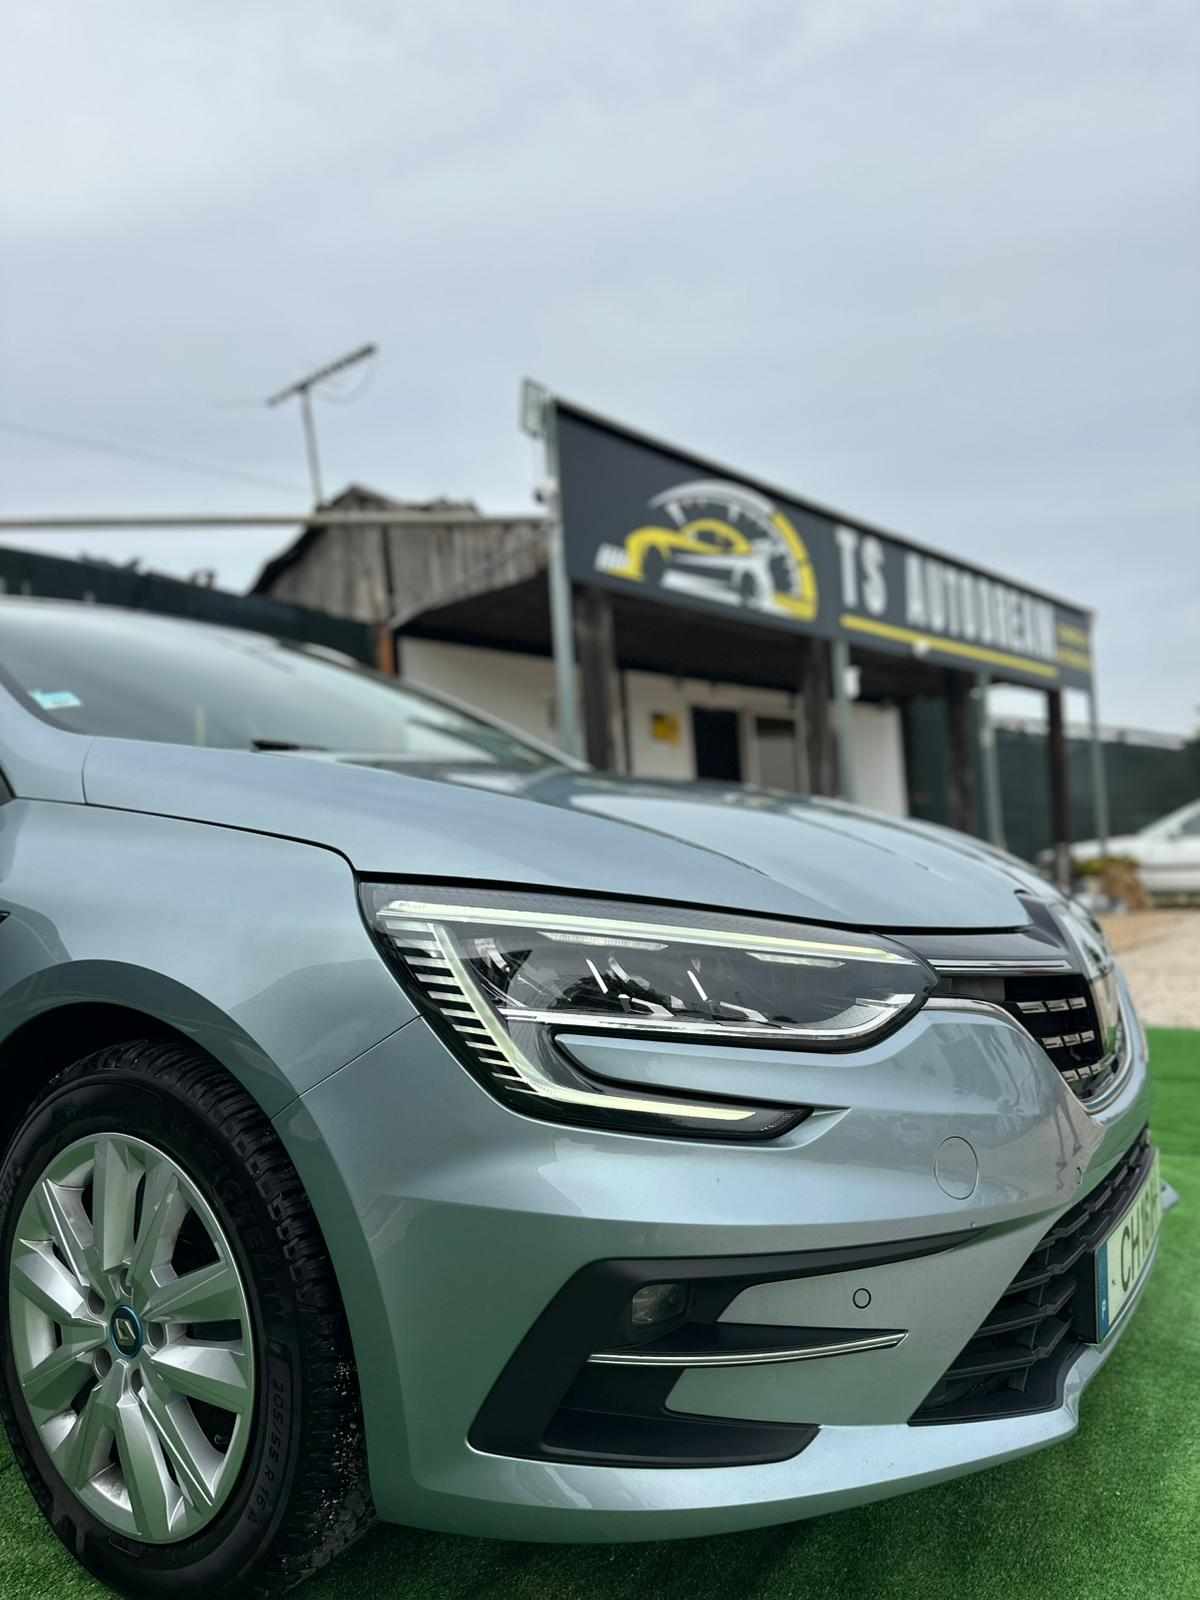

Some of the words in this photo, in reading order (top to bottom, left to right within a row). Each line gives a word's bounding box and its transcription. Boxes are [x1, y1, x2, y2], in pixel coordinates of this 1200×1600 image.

[834, 526, 886, 615] TS
[268, 1377, 284, 1463] 205/55
[256, 1487, 269, 1511] 16
[264, 1464, 275, 1482] R
